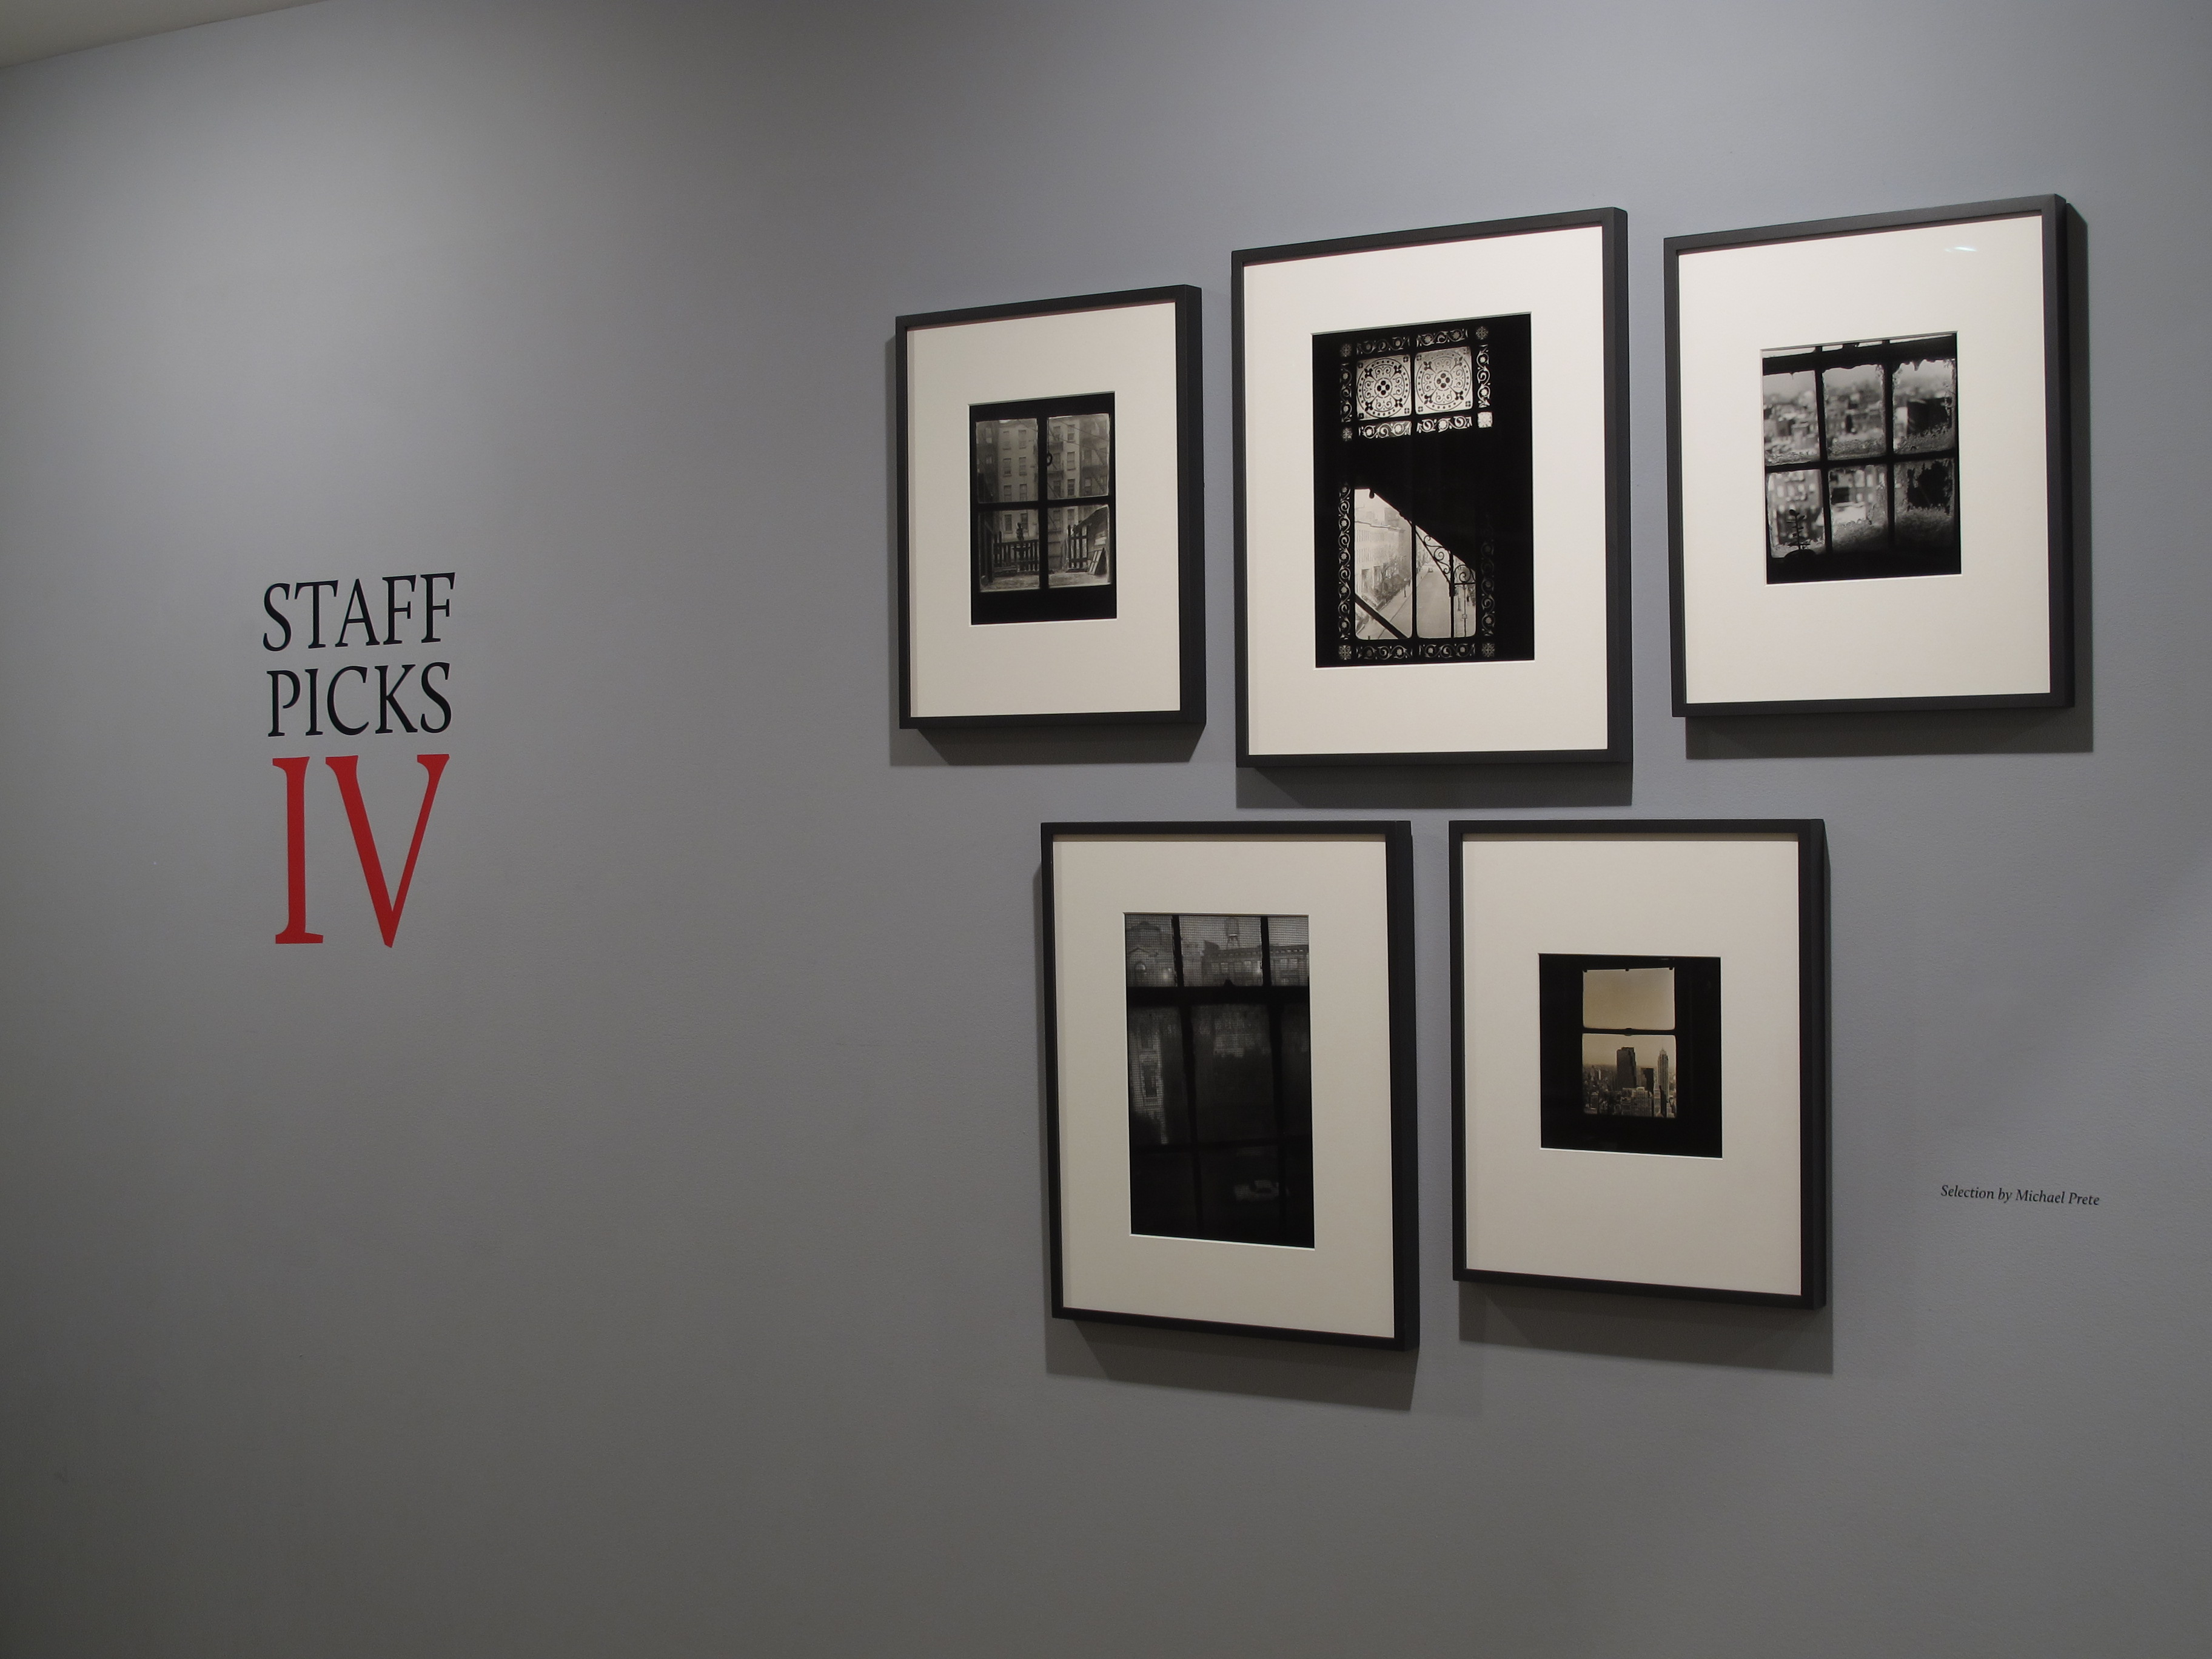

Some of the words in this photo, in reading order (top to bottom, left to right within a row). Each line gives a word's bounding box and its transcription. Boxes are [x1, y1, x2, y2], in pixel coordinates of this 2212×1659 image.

[263, 572, 455, 652] STAFF
[266, 662, 452, 737] PICKS
[272, 753, 450, 948] IV
[1940, 1184, 1994, 1199] Selection
[1997, 1187, 2013, 1204] by
[2016, 1189, 2065, 1204] Michael
[2068, 1192, 2100, 1205] Prete
